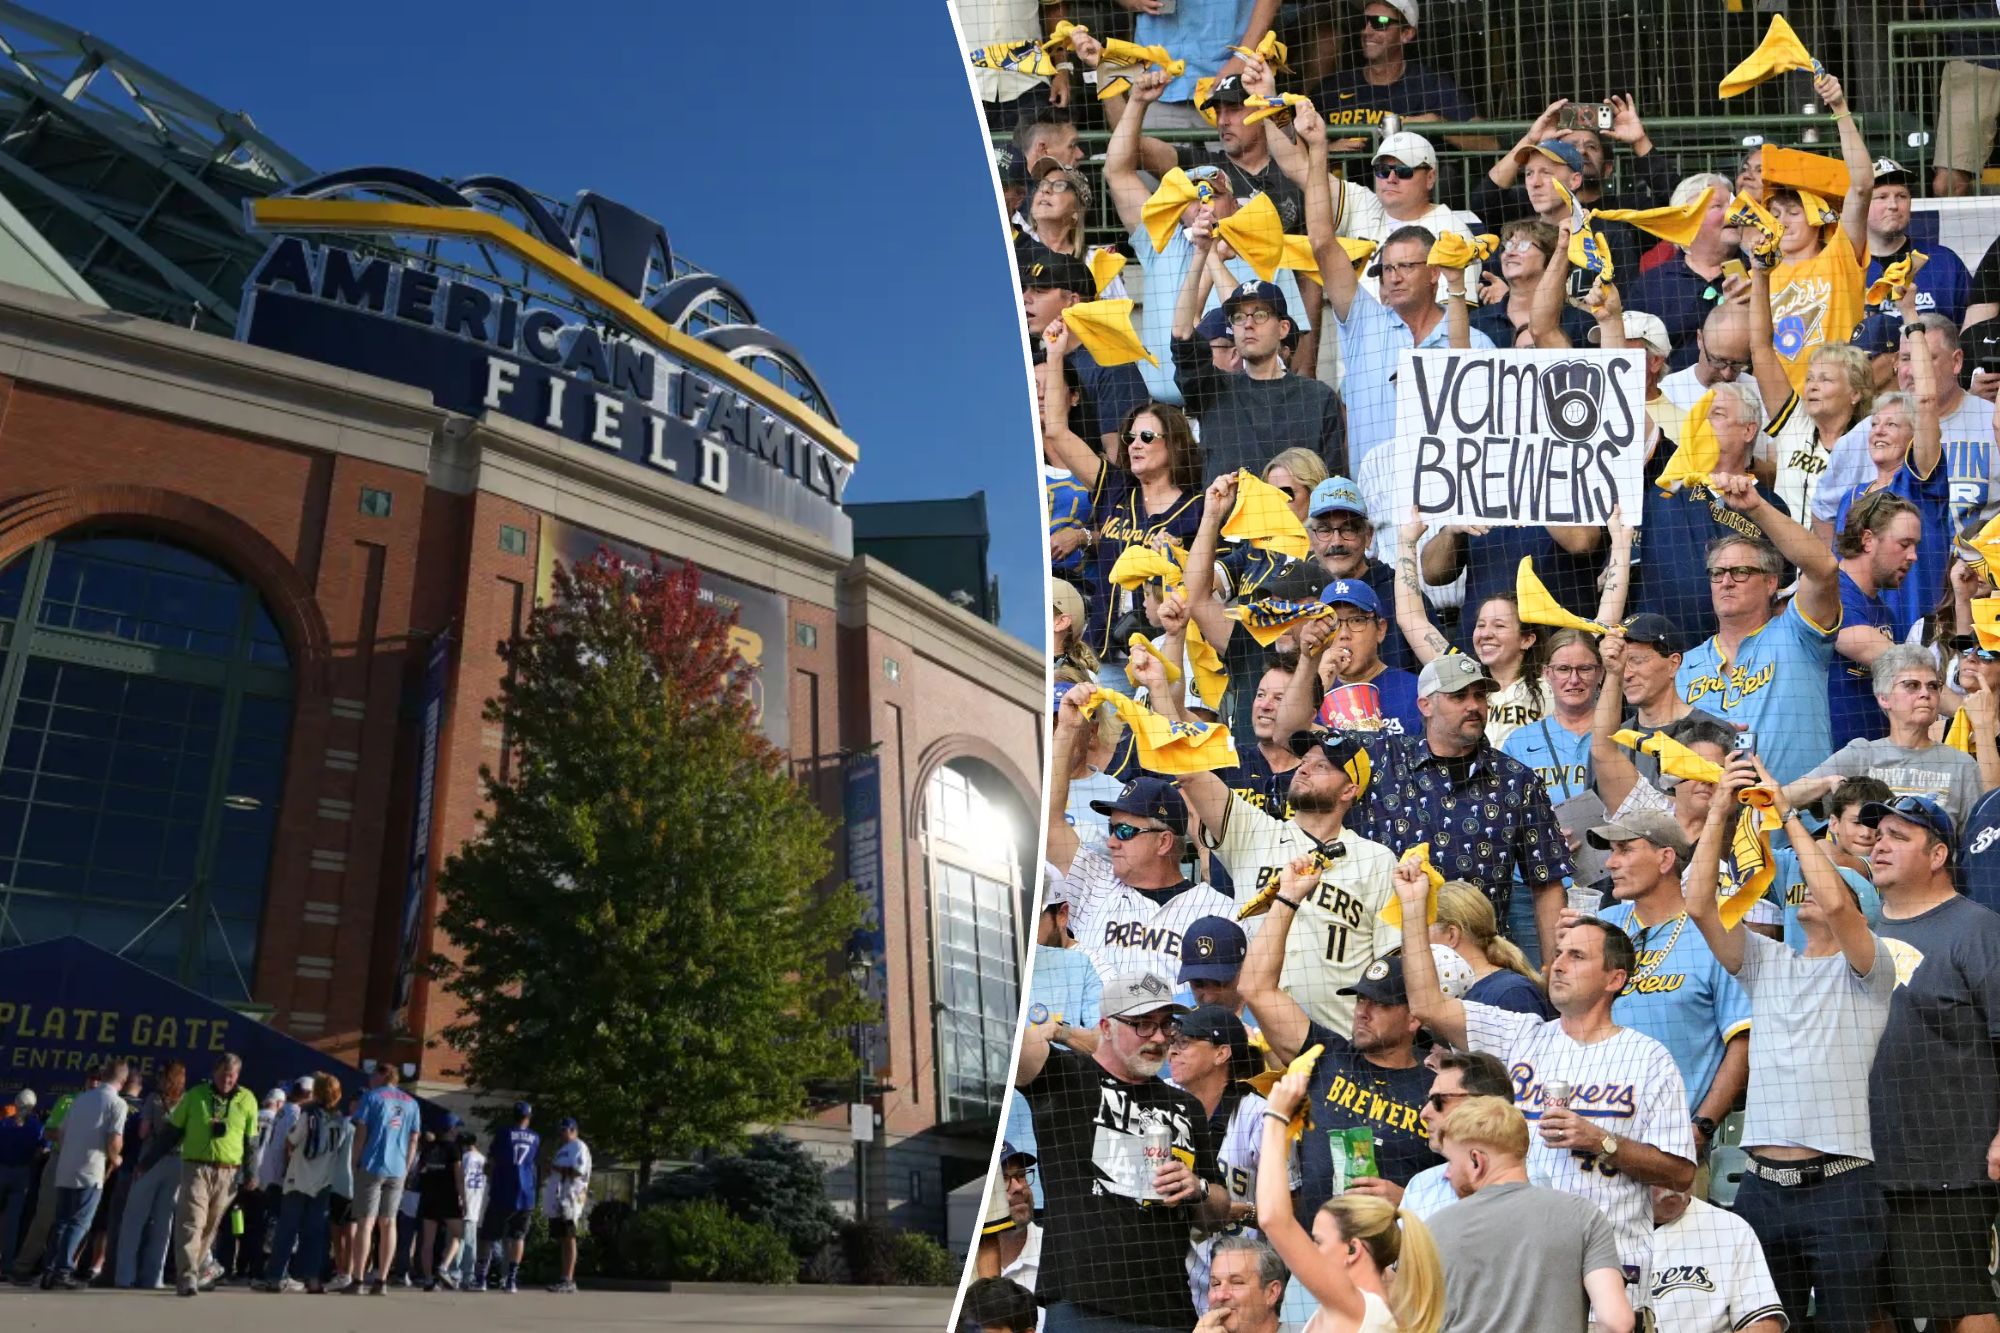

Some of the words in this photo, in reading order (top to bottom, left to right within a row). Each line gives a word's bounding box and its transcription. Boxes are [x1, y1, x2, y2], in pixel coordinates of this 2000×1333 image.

[246, 234, 655, 401] AMERICAN
[680, 369, 852, 506] FAMILY
[484, 356, 730, 495] FIELD
[1413, 437, 1621, 524] BREWERS
[1335, 581, 1349, 595] LA
[1325, 925, 1348, 963] 11
[131, 1014, 229, 1051] GATE
[513, 1143, 531, 1166] 17
